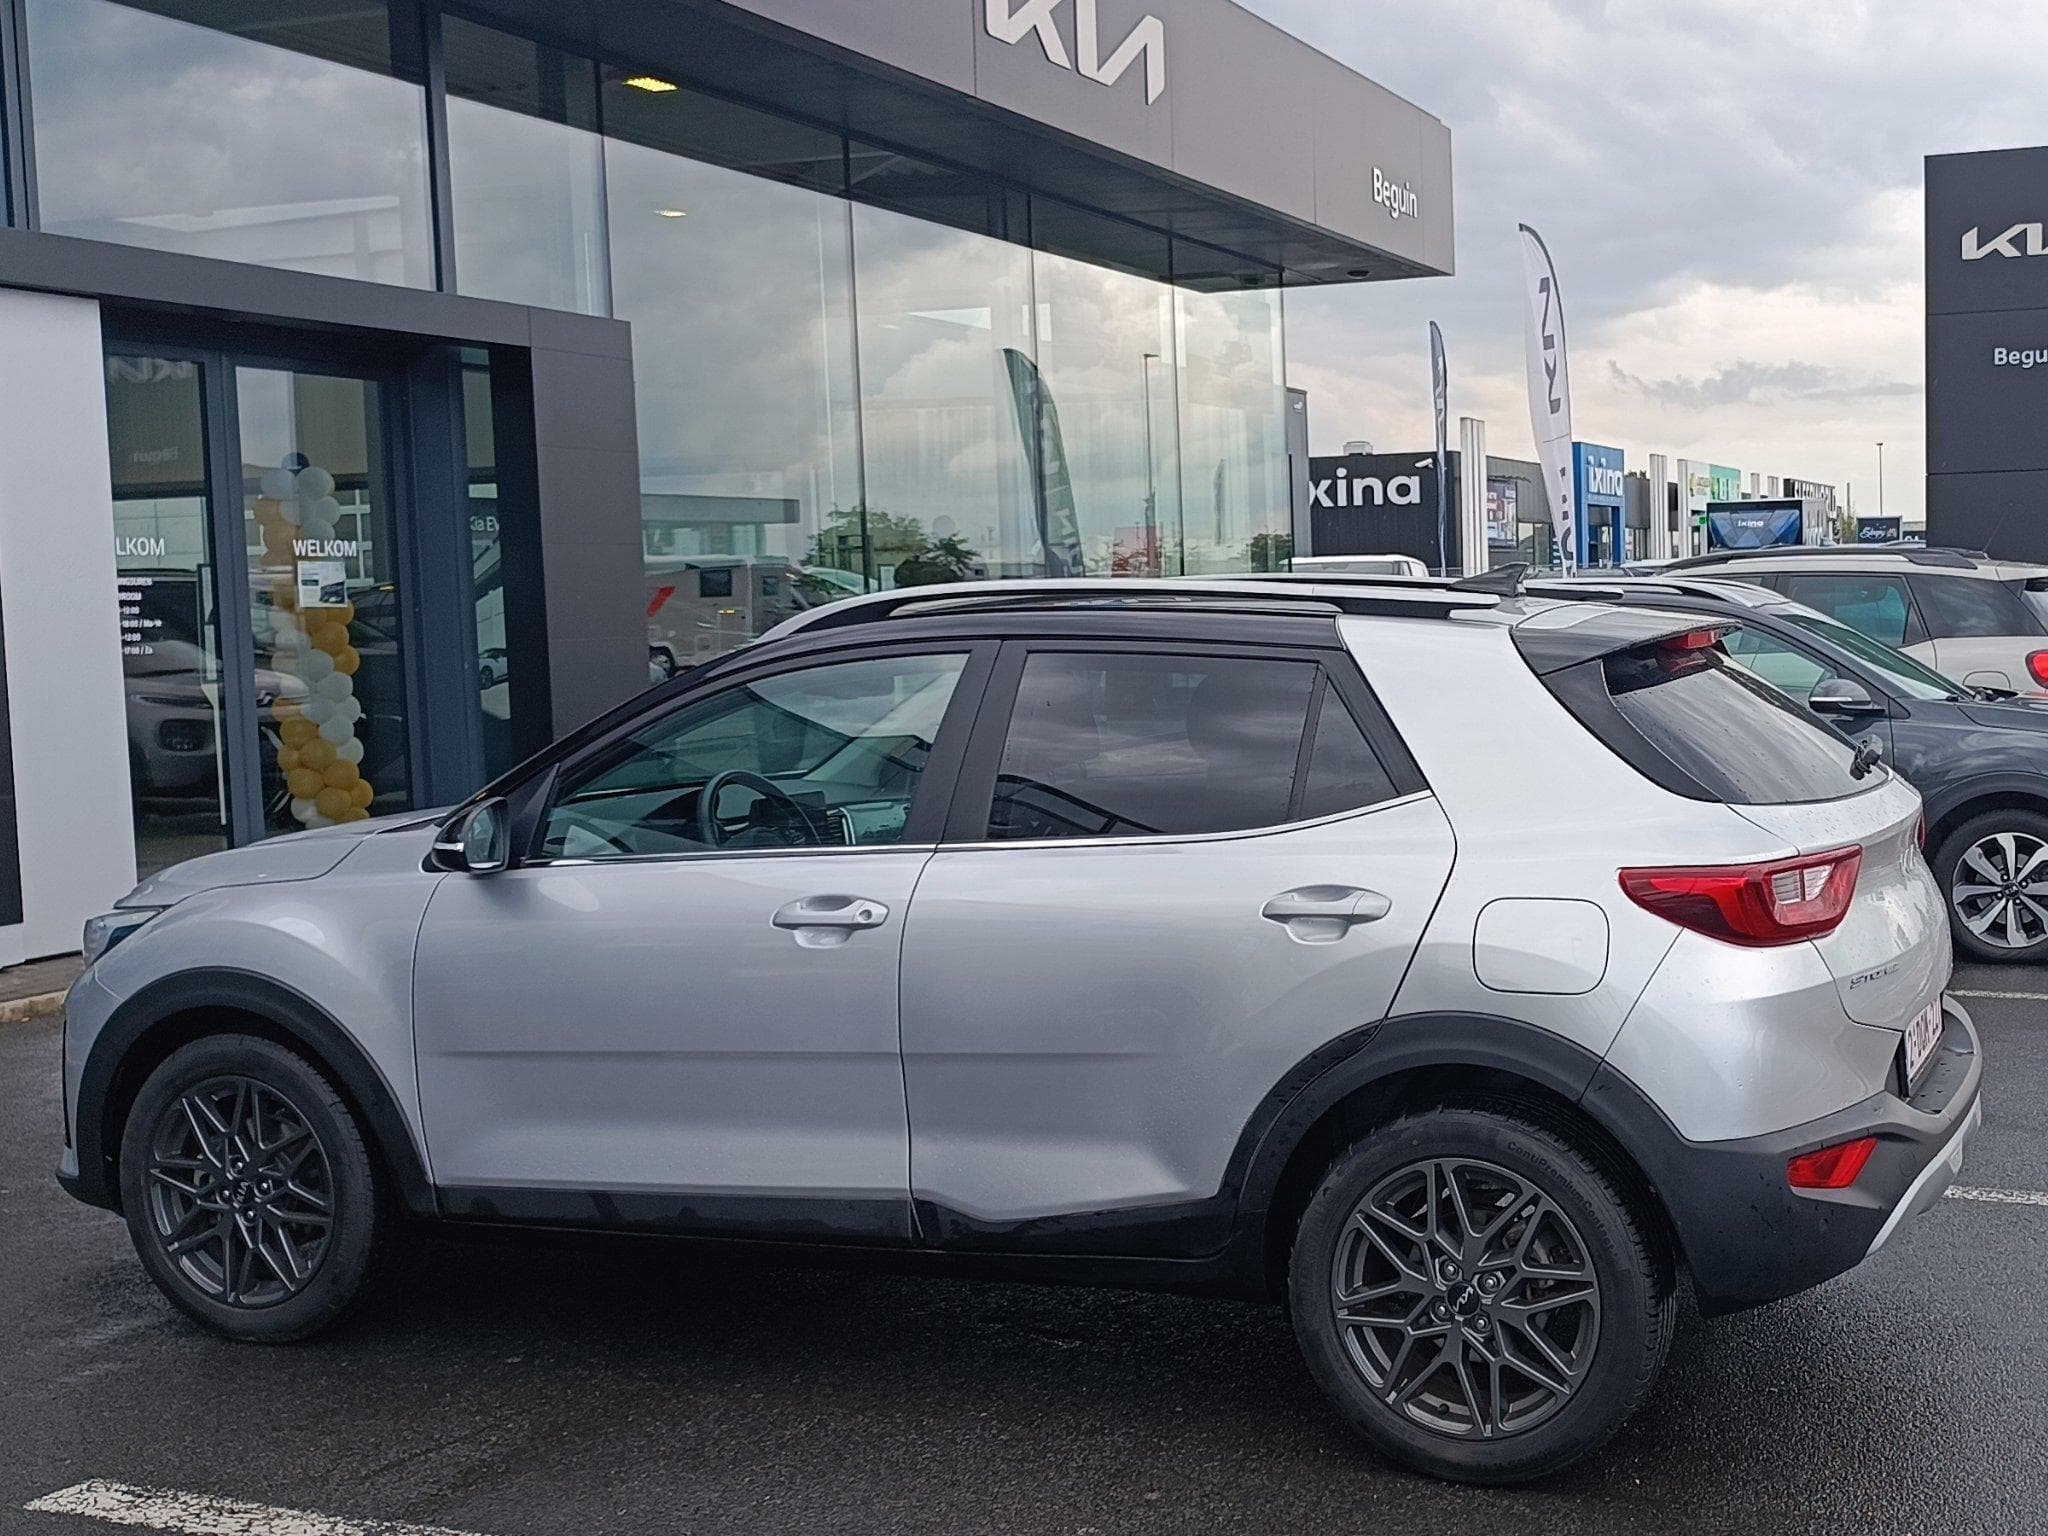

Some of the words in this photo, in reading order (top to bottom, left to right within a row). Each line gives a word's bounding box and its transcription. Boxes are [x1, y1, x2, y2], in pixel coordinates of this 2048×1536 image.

[1371, 167, 1418, 219] Beguin
[1961, 222, 2048, 260] KI
[1993, 347, 2048, 369] Begu
[1587, 455, 1624, 496] ixina
[292, 538, 357, 557] WELKOM
